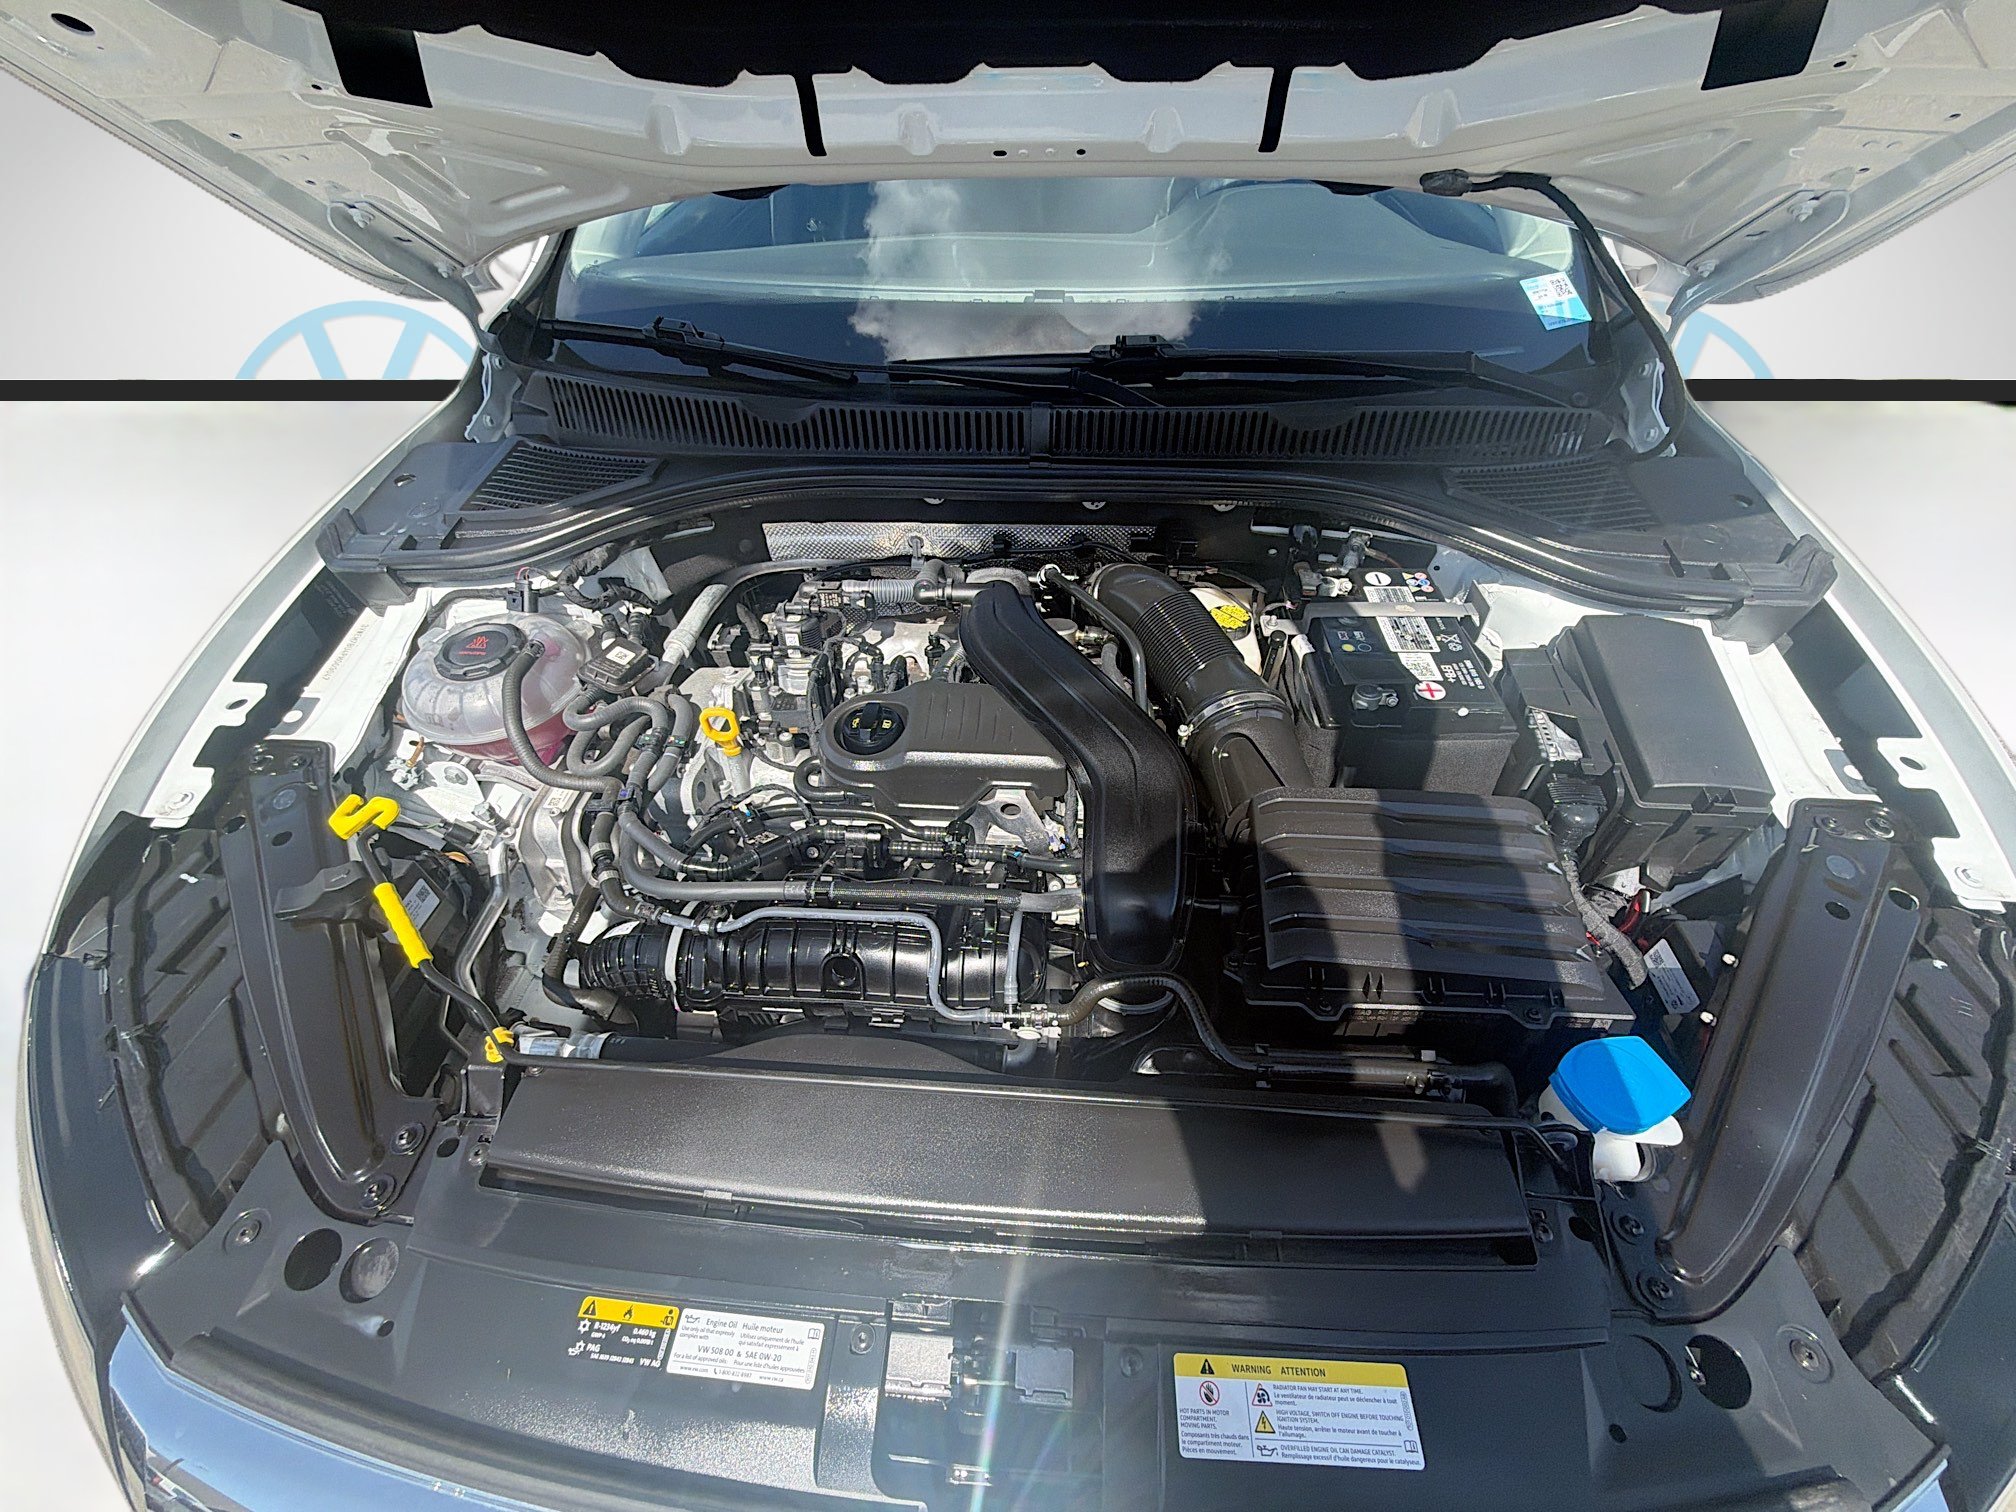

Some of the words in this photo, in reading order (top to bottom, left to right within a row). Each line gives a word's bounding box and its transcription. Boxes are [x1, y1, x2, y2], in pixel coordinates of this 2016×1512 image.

[594, 1322, 621, 1333] R-1234yf
[706, 1319, 727, 1328] Engine
[742, 1323, 759, 1331] Huile
[715, 1330, 735, 1338] expressly
[757, 1335, 784, 1343] uniquement
[586, 1343, 601, 1352] PAG
[698, 1345, 709, 1353] VW
[710, 1346, 723, 1355] 508
[745, 1351, 758, 1359] SAE
[759, 1353, 782, 1362] 0W-20
[639, 1357, 651, 1366] VW
[651, 1360, 661, 1368] AG
[1231, 1363, 1272, 1374] WARNING
[1281, 1367, 1326, 1377] ATTENTION
[1351, 1456, 1376, 1464] dangereux
